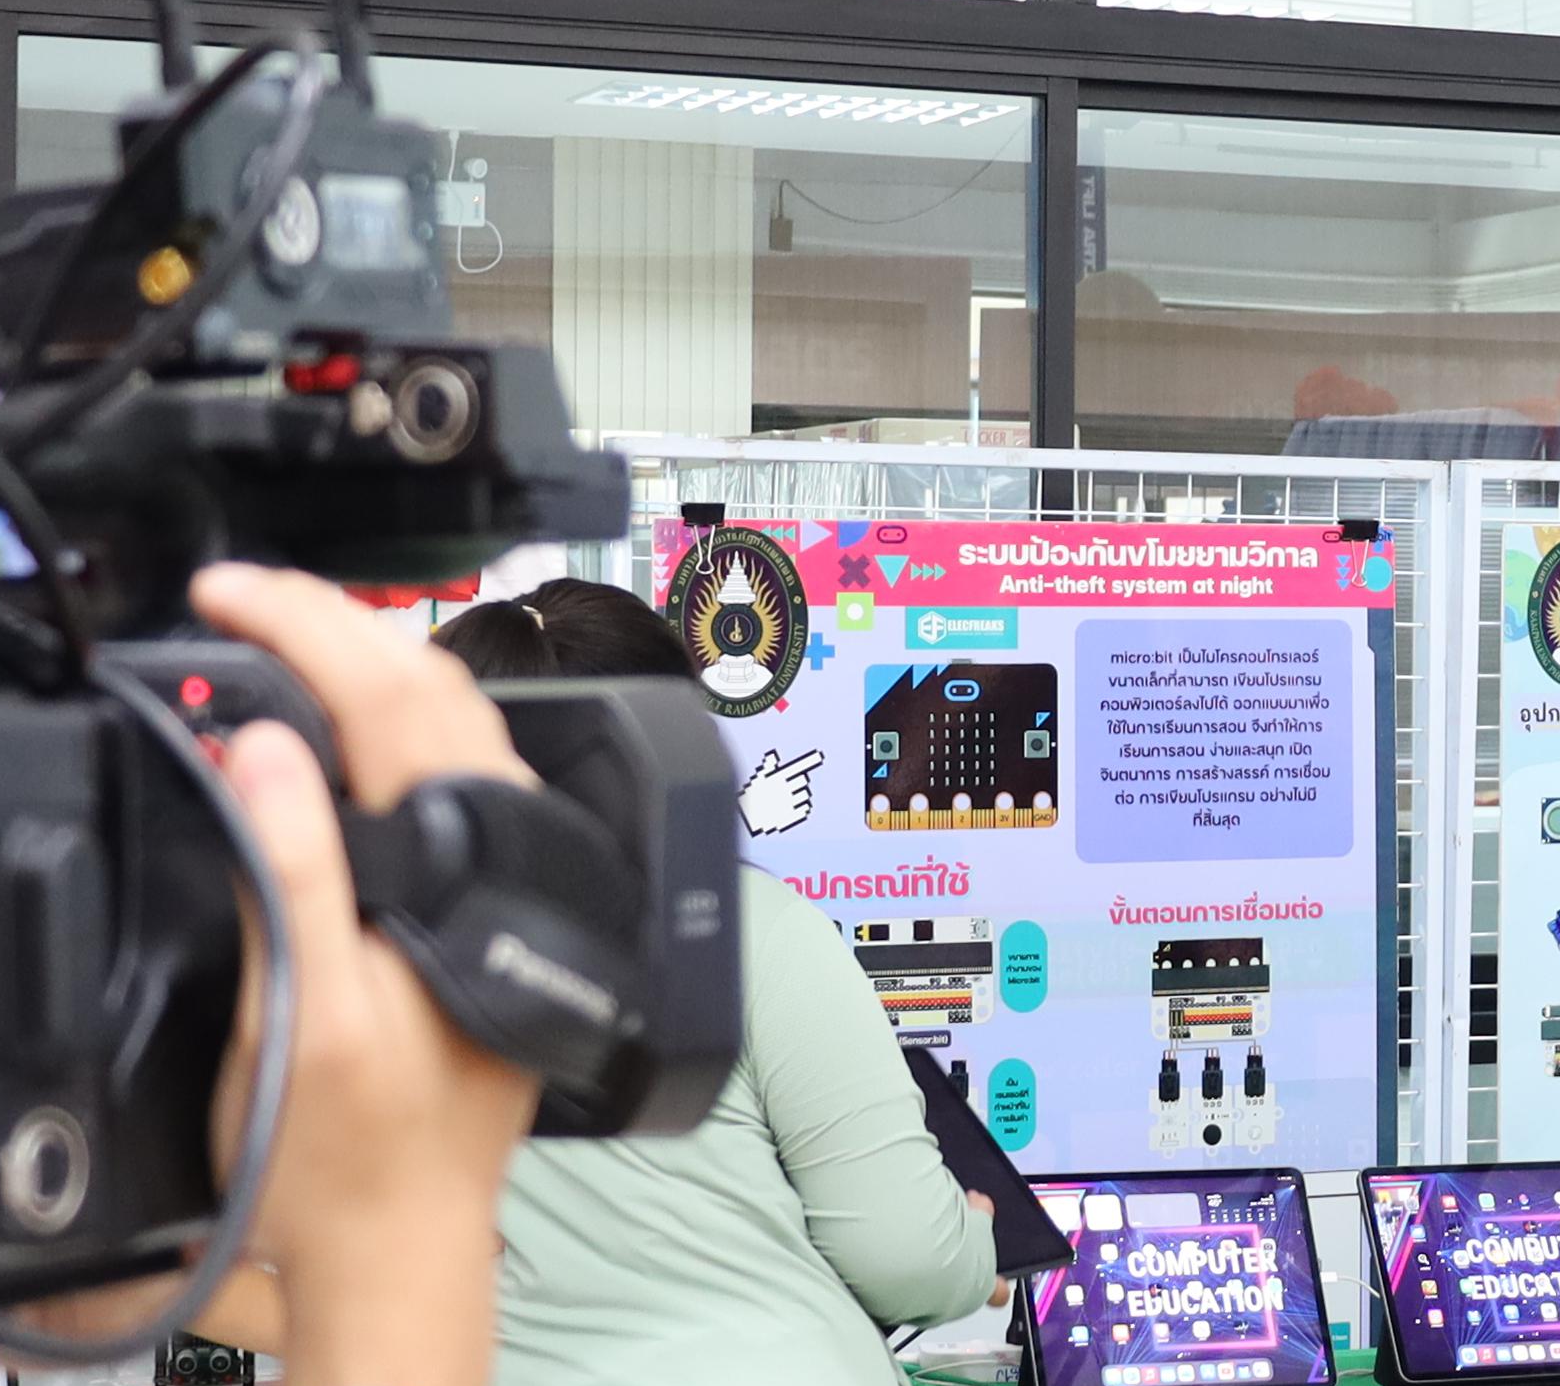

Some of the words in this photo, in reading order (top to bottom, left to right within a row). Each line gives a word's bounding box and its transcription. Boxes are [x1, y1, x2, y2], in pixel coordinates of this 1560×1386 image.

[958, 538, 1318, 569] ระบบป้องกันขโมยยามวิกาล
[999, 574, 1105, 594] Anti-theft
[1111, 578, 1188, 597] system
[1193, 578, 1216, 594] at
[1221, 575, 1274, 597] night
[1110, 649, 1173, 664] micro:bit
[724, 687, 779, 716] RAJABHAT
[776, 622, 805, 688] UNIVERSITY
[1109, 669, 1228, 688] ขนาดเล็กที่สามารถ
[1233, 672, 1322, 687] เขียนโปรแกรม
[1233, 691, 1330, 710] ออกแบบมาเพื่อ
[1107, 719, 1247, 735] ใช้ในการเรียนการสอน
[1119, 742, 1205, 758] เรียนการสอน
[1209, 742, 1285, 760] ง่ายและสนุก
[1289, 742, 1312, 756] เปิด
[1100, 767, 1171, 782] จินตนาการ
[1176, 764, 1269, 781] การสร้างสรรค์
[1274, 760, 1330, 779] การเชื่อม
[1115, 790, 1134, 806] ต่อ
[1139, 788, 1255, 805] การเขียนโปรแกรม
[1260, 786, 1317, 803] อย่างไม่มี
[1193, 808, 1240, 830] ที่สิ้นสุด
[1109, 892, 1323, 925] ขั้นตอนการเชื่อมต่อ
[1126, 1246, 1278, 1278] COMPUTER
[1127, 1283, 1284, 1317] EDUCATION
